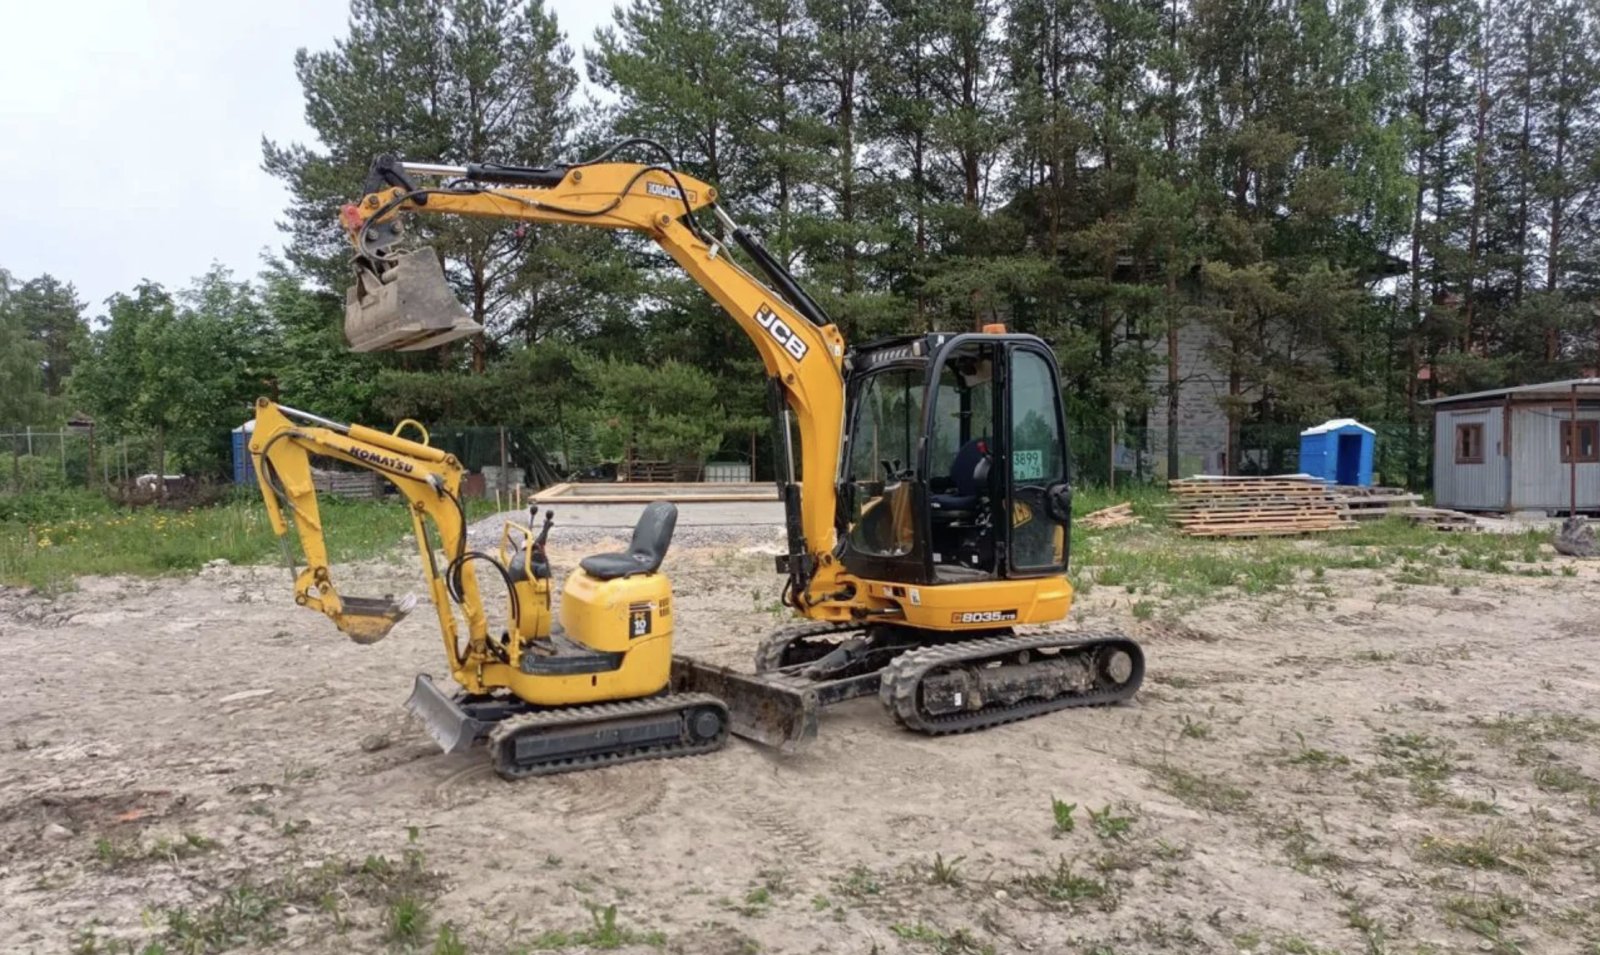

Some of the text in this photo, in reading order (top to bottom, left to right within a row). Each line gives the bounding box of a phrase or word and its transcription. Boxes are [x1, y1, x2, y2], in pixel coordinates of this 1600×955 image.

[756, 311, 807, 360] JCB
[350, 446, 413, 473] KOMATSU
[1014, 452, 1038, 465] 3899
[634, 619, 647, 630] 10
